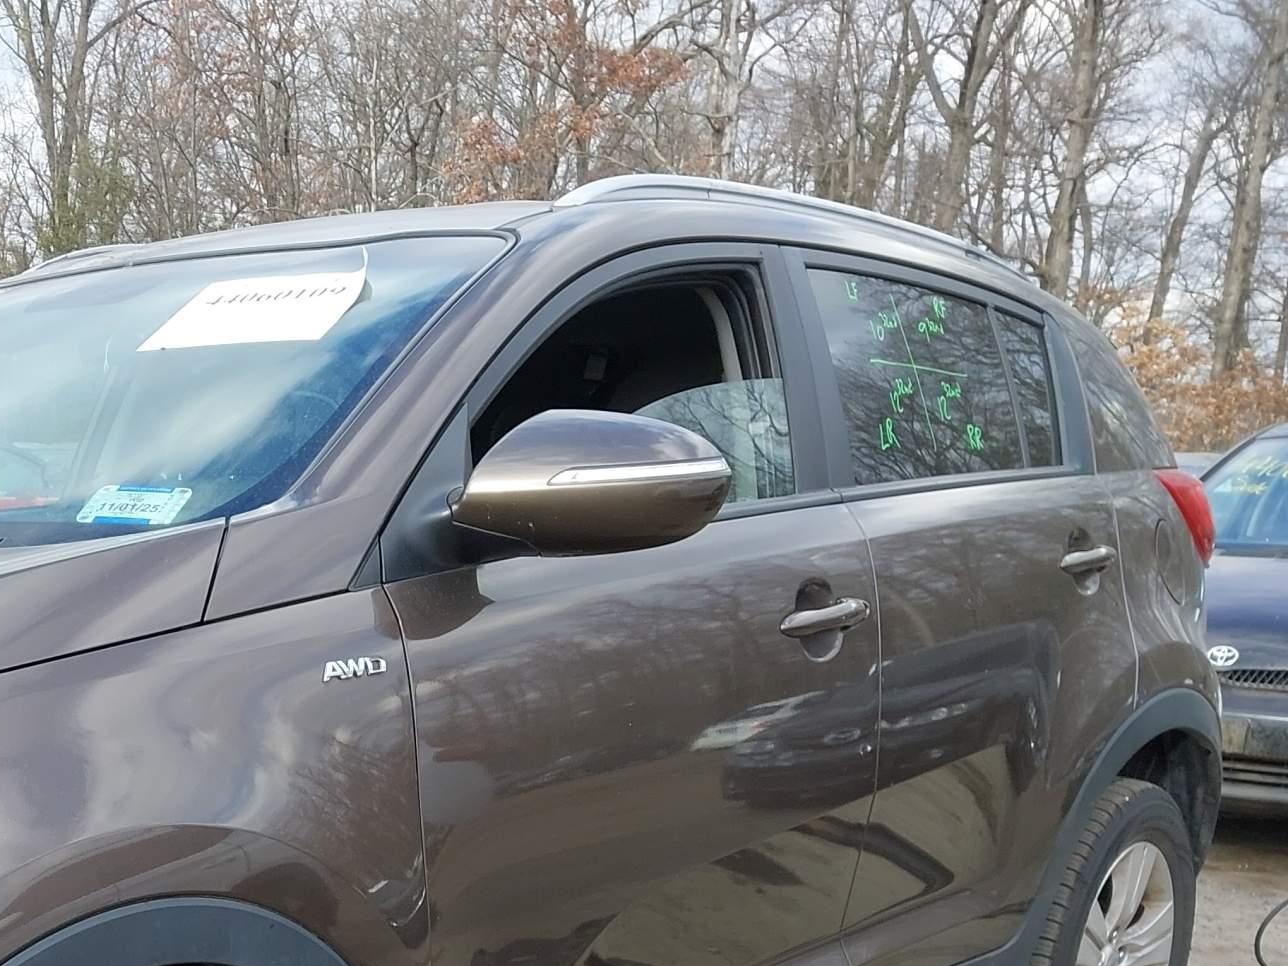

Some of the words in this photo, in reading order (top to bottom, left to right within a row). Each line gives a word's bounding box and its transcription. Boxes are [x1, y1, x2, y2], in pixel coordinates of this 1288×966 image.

[844, 280, 858, 301] LF
[932, 296, 947, 319] RF
[879, 417, 902, 450] LR
[967, 424, 985, 450] RR
[323, 657, 387, 682] AWD
